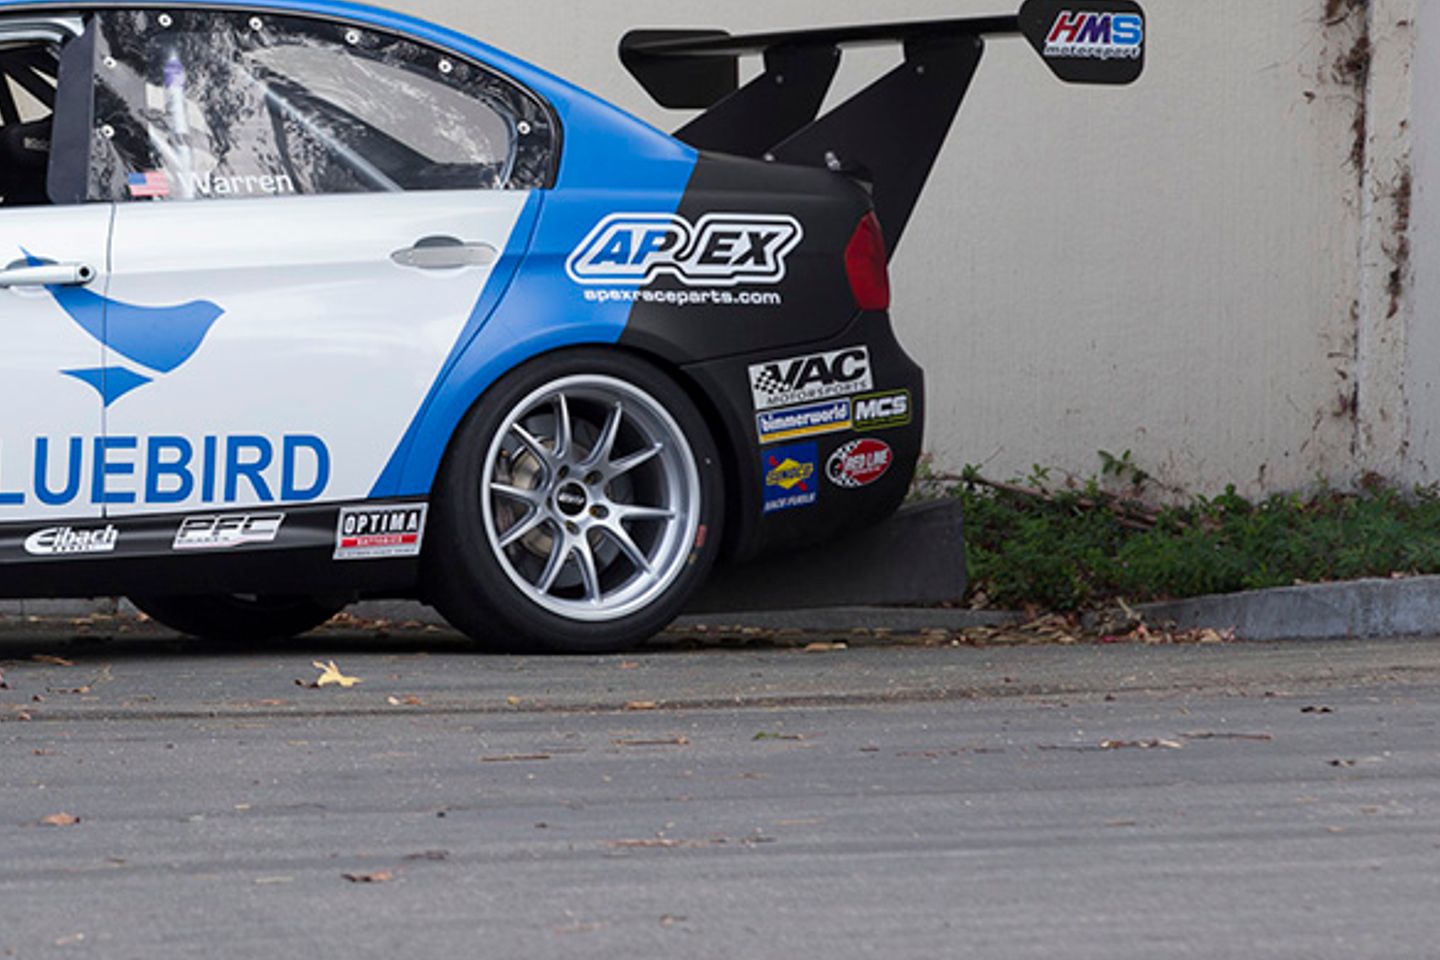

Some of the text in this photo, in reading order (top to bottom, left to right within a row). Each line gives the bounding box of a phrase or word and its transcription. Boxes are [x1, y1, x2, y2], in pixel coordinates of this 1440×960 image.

[1046, 11, 1142, 46] HMS
[177, 171, 295, 194] Warren
[583, 289, 781, 306] apexraceparts.com
[759, 349, 866, 391] VAC
[855, 394, 908, 422] MCS
[343, 511, 418, 534] OPTIMA
[24, 524, 119, 555] Eibach
